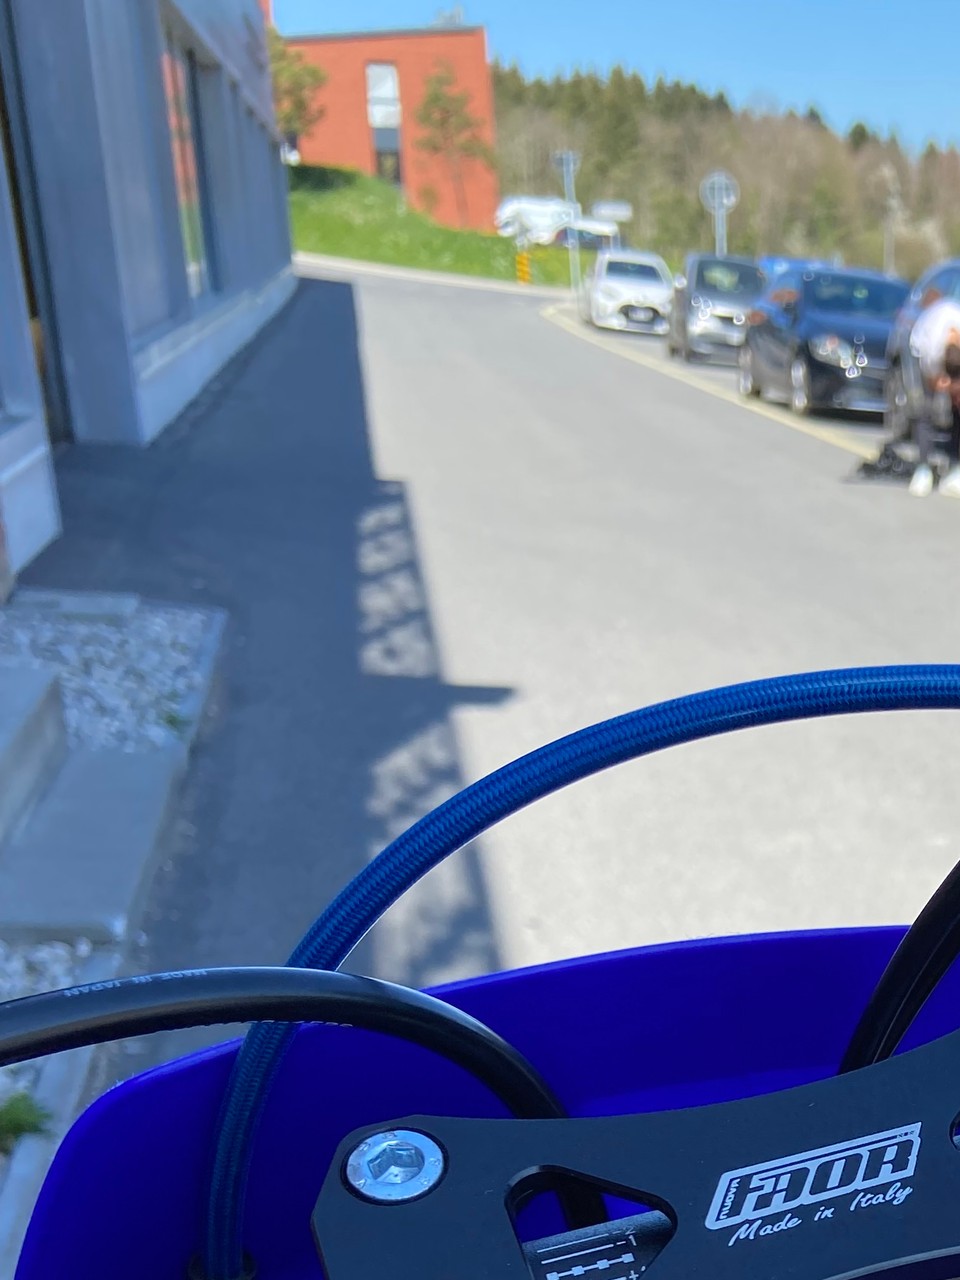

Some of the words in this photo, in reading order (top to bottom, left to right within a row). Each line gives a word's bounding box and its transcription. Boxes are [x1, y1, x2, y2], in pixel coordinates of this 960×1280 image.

[62, 980, 121, 997] JAPAN
[728, 1213, 802, 1247] Made
[813, 1206, 835, 1222] in
[849, 1181, 914, 1212] Italy
